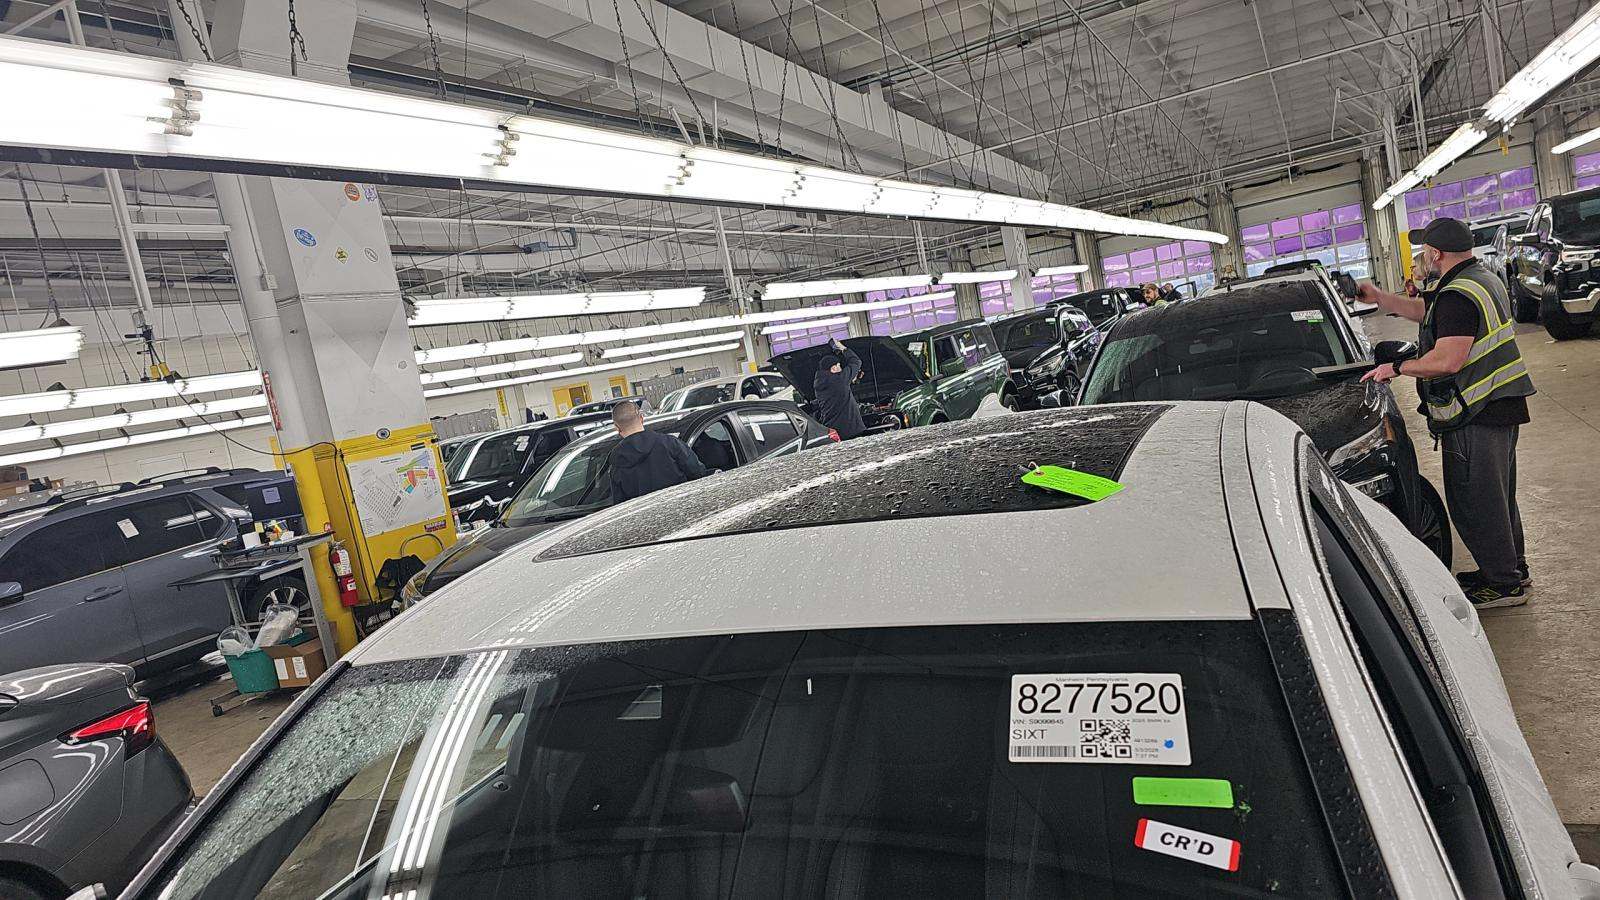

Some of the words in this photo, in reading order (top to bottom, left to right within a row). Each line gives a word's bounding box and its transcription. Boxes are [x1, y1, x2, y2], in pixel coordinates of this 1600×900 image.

[1017, 682, 1181, 715] 8277520
[1012, 729, 1047, 740] SIXT
[1160, 831, 1215, 856] CR'D
